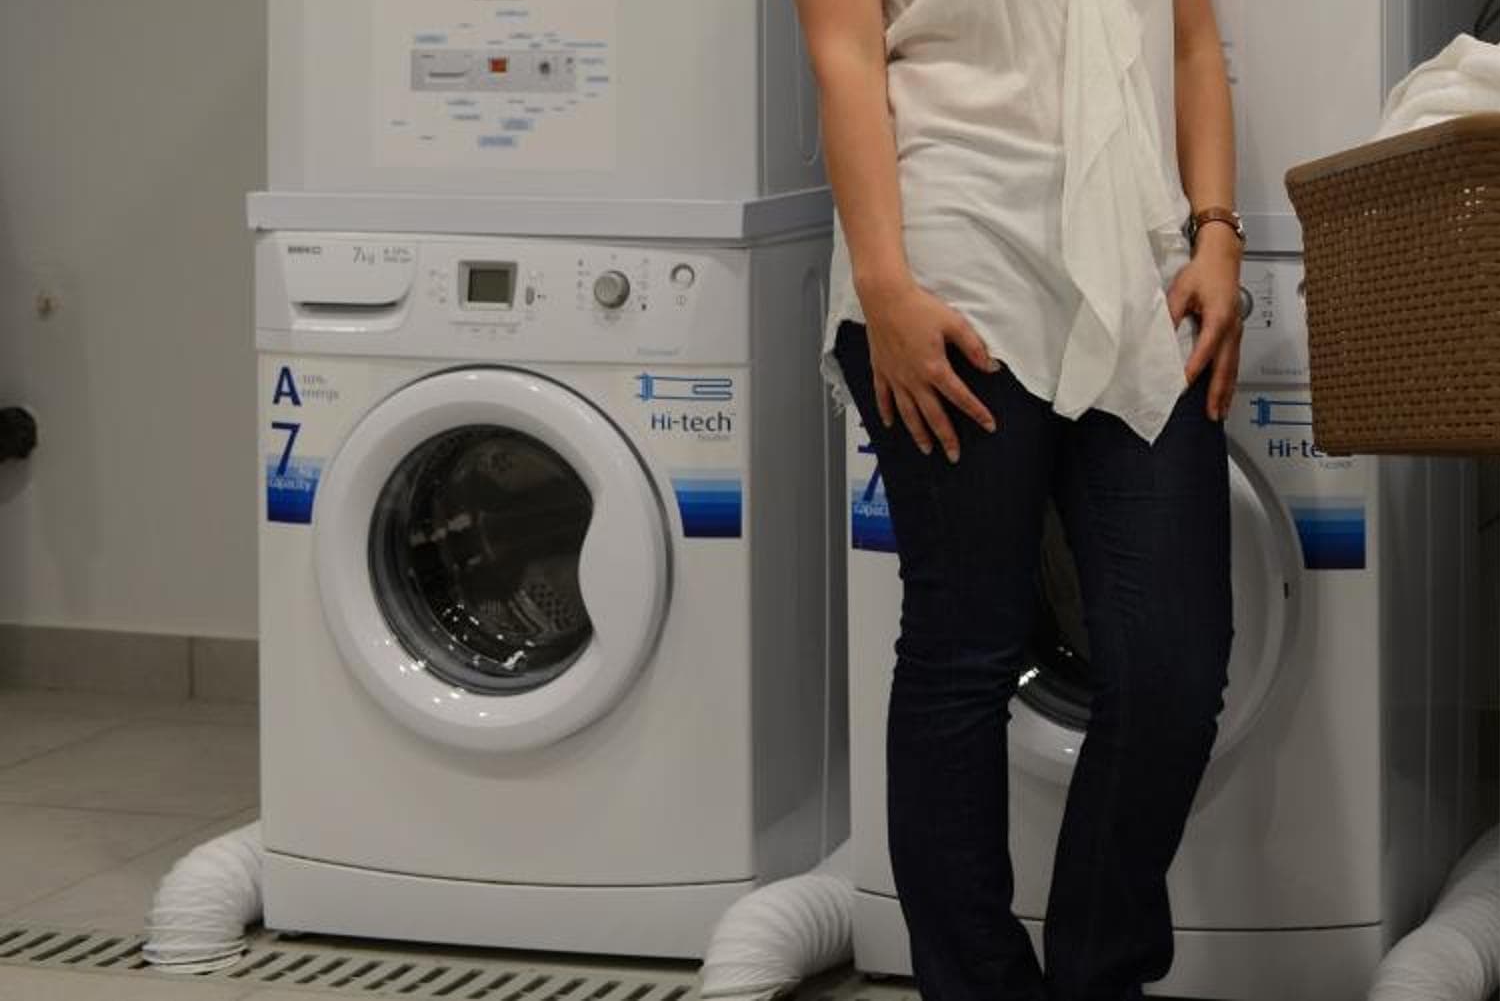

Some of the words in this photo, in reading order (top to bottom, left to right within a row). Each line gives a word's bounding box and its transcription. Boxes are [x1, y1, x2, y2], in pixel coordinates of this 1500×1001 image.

[272, 366, 303, 406] A
[650, 411, 732, 433] Hi-tech
[271, 421, 302, 476] 7
